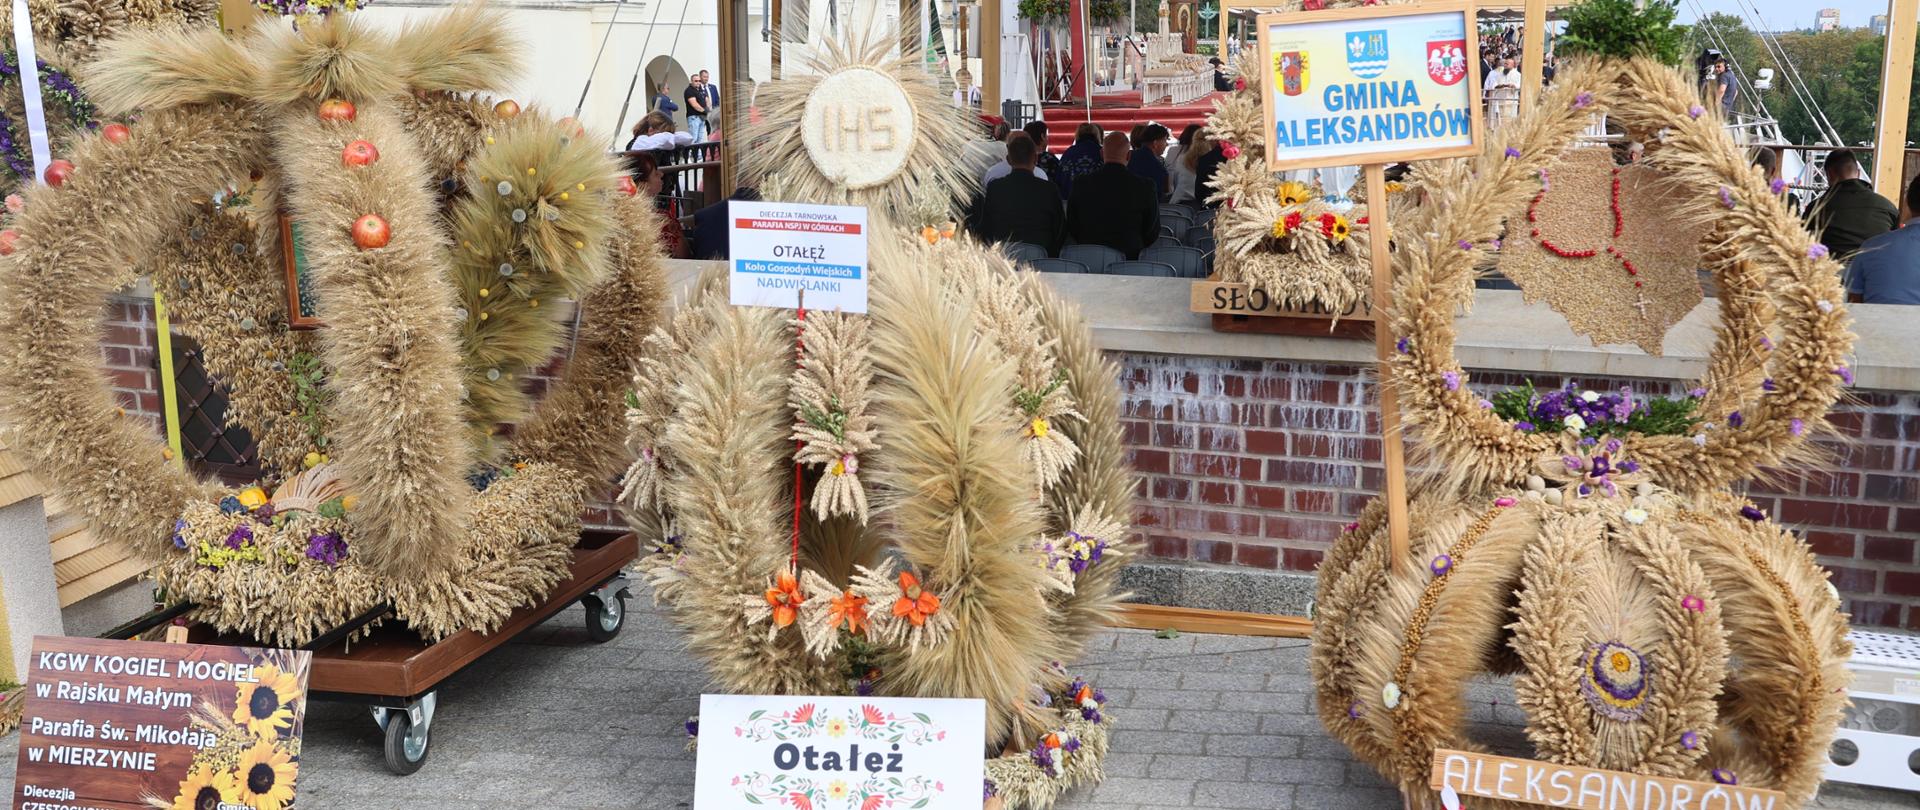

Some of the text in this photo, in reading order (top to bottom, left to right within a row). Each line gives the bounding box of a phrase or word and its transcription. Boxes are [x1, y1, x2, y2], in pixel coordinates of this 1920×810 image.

[1323, 80, 1420, 112] GMINA
[823, 104, 896, 152] IHS
[1276, 103, 1470, 148] ALEKSANDRÓW
[752, 220, 784, 229] PARAFIA
[785, 222, 801, 230] NSPJ
[811, 222, 845, 232] GÓRKACH
[760, 210, 838, 221] DIECEZJA TARNOWSKA
[773, 245, 825, 263] OTAŁĘŻ
[745, 262, 853, 277] Koło Gospodyń Wiejskich
[757, 277, 841, 293] NADWIŚLANKI
[39, 651, 260, 683] KGW KOGIEL MOGIEL
[36, 681, 192, 710] w Rajsku Małym
[31, 717, 217, 751] Parafia Św. Mikołaja
[28, 746, 156, 771] w MIERZYNIE
[773, 742, 903, 779] Otałęż
[23, 785, 75, 801] Diecezjia
[1443, 754, 1776, 810] ALEKSANDRÓW
